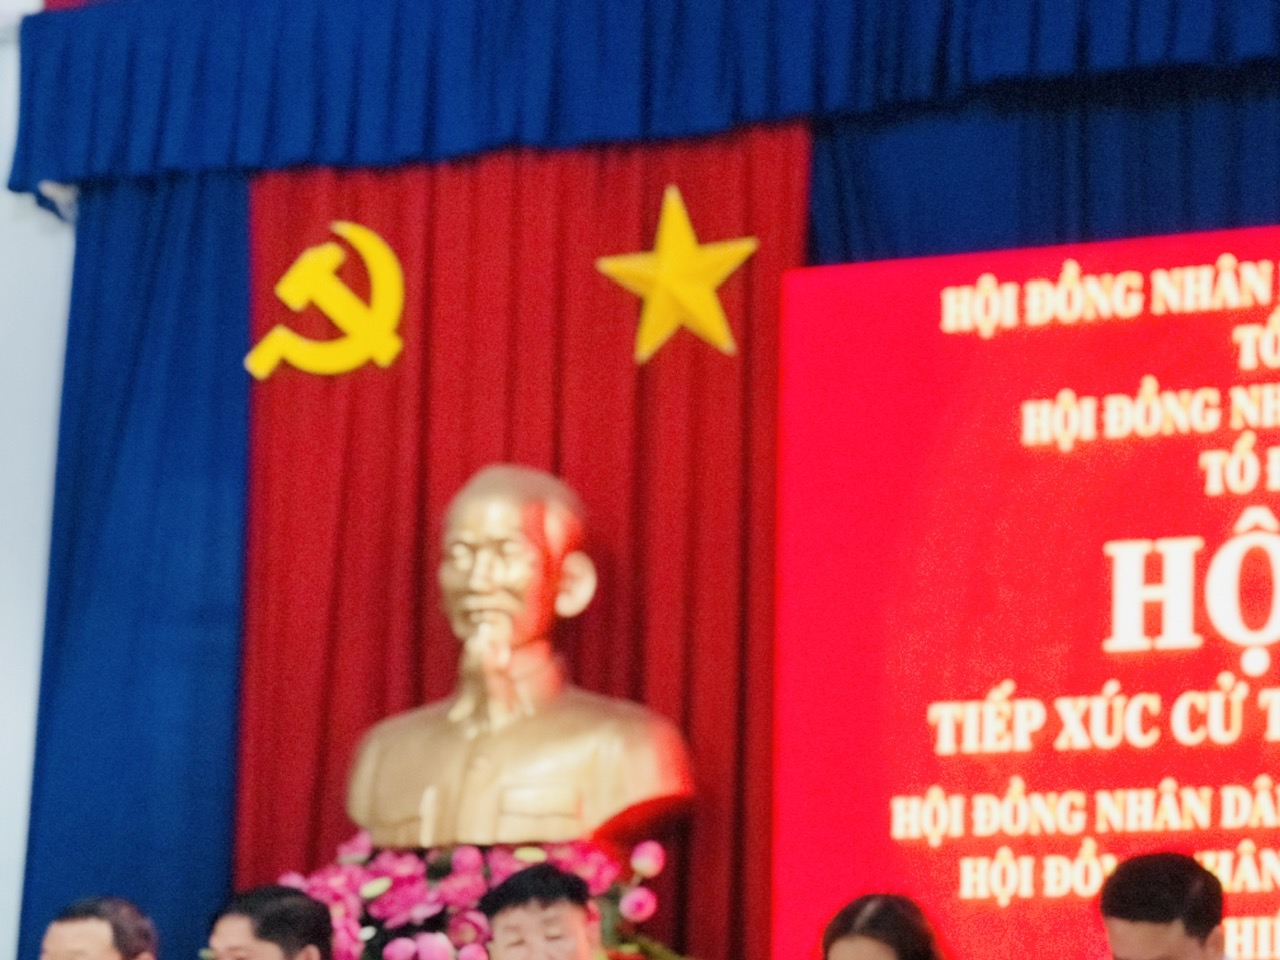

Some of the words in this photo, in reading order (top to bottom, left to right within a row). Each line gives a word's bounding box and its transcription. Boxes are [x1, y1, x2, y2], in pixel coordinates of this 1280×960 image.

[942, 275, 1018, 337] HỘI
[1025, 261, 1143, 326] ĐỒNG
[1152, 254, 1272, 314] NHÂN
[1022, 390, 1096, 451] HỘI
[1103, 376, 1221, 439] ĐỒNG
[1200, 430, 1260, 495] TỔ
[928, 680, 1046, 755] TIẾP
[1055, 680, 1160, 750] XÚC
[1171, 672, 1249, 745] CỬ
[892, 786, 965, 847] HỘI
[972, 776, 1086, 837] ĐỒNG
[1096, 778, 1212, 833] NHÂN
[959, 846, 1035, 907] HỘI
